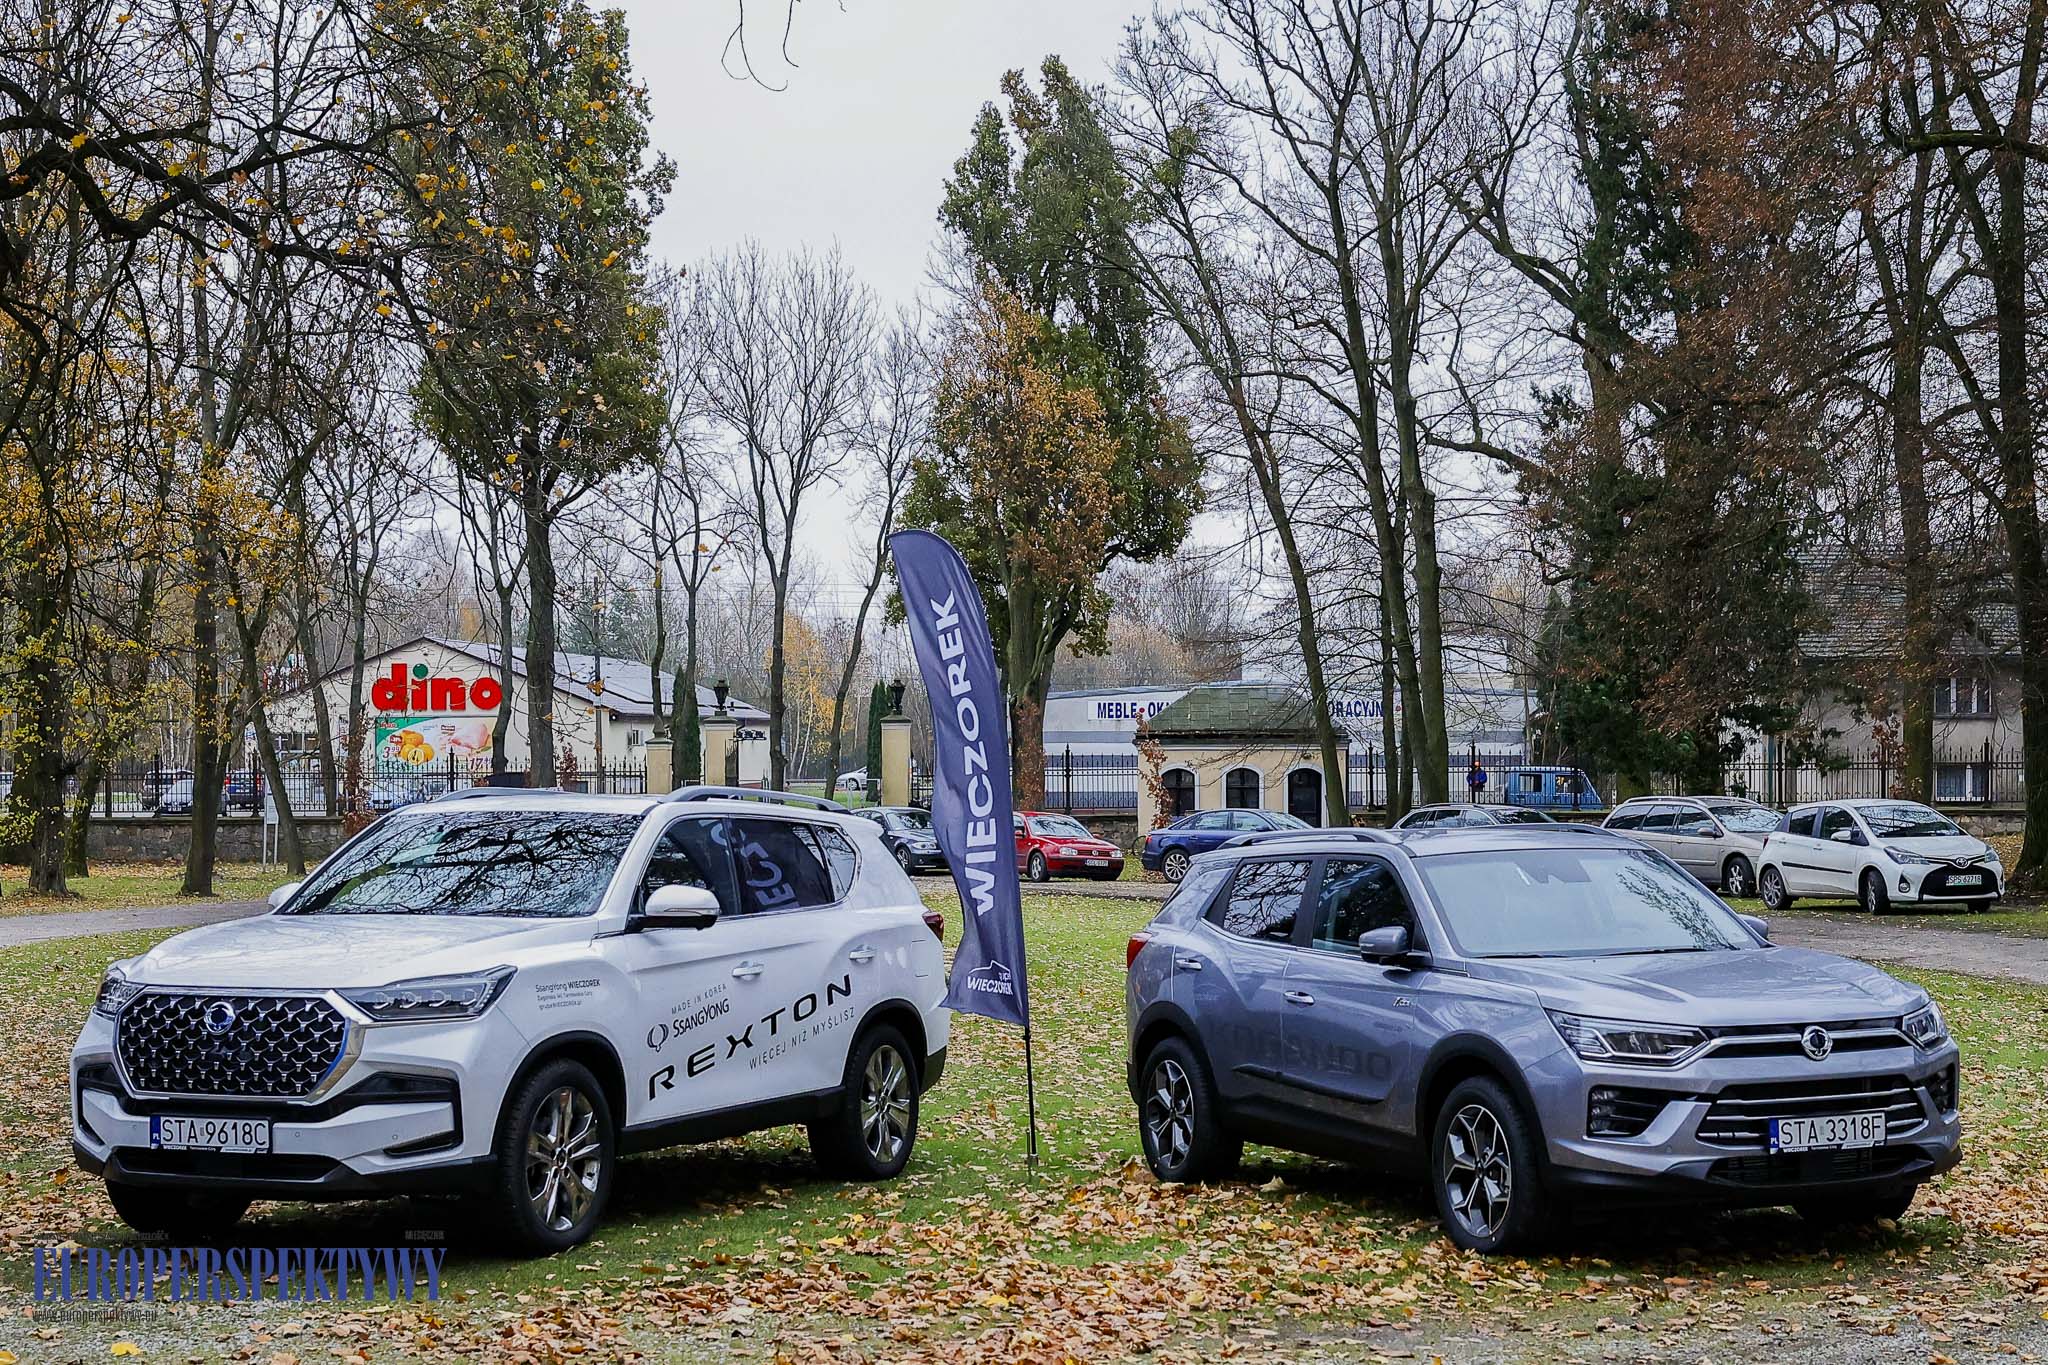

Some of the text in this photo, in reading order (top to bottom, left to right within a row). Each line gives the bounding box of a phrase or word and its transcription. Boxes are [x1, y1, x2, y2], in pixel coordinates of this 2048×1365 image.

[371, 663, 503, 711] dino
[1097, 702, 1137, 719] MEBLE
[1148, 702, 1169, 718] OK
[929, 590, 997, 917] WIECZOREK
[671, 983, 727, 1015] MADE IN KOREA
[967, 976, 1014, 996] WIECZOREK
[649, 973, 852, 1101] REXTON
[749, 1042, 786, 1070] WIĘCEJ
[812, 1007, 855, 1038] MYŚLISZ
[162, 1119, 199, 1144] STA
[204, 1121, 266, 1146] 9618C
[1780, 1120, 1819, 1145] STA
[1825, 1115, 1883, 1143] 3318F
